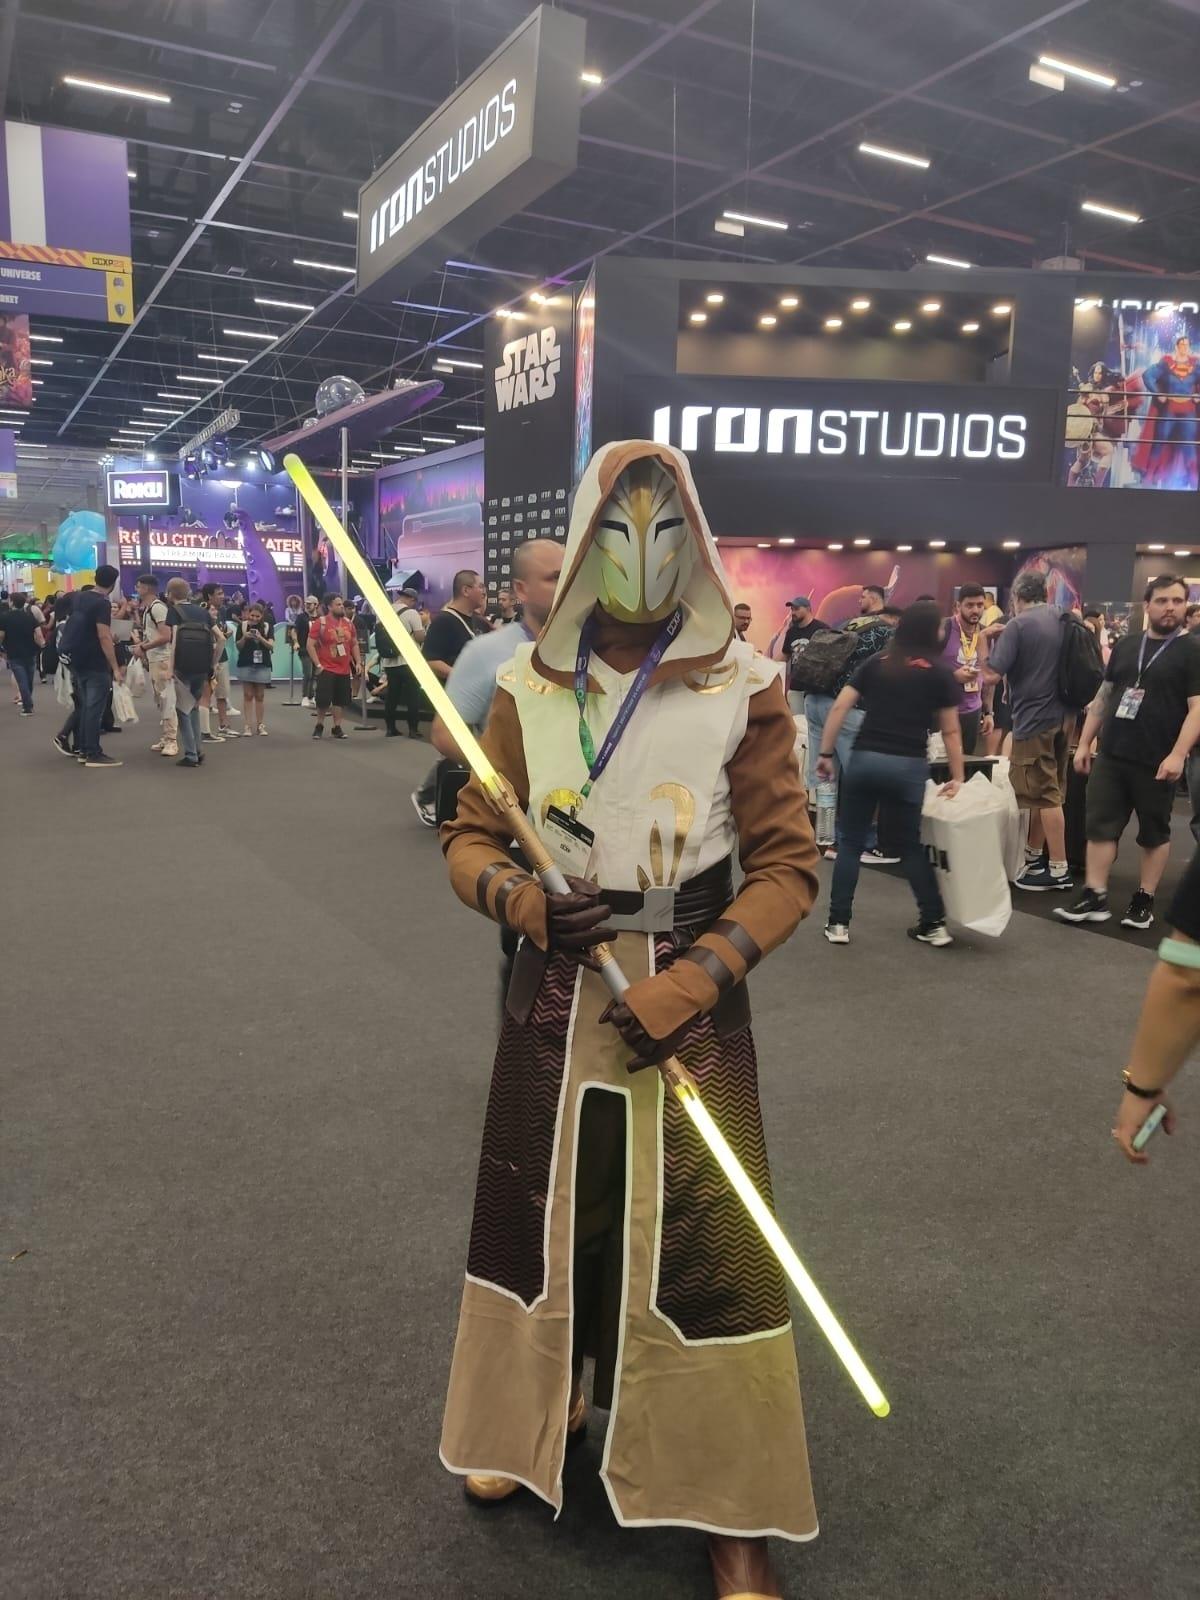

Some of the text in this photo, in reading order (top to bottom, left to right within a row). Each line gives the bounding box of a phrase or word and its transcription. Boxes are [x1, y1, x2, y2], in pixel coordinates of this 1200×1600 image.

[0, 267, 41, 281] UNIVERSE
[495, 326, 561, 381] STAR
[495, 359, 561, 413] WARS
[817, 409, 1028, 460] STUDIOS
[172, 532, 209, 548] CITY
